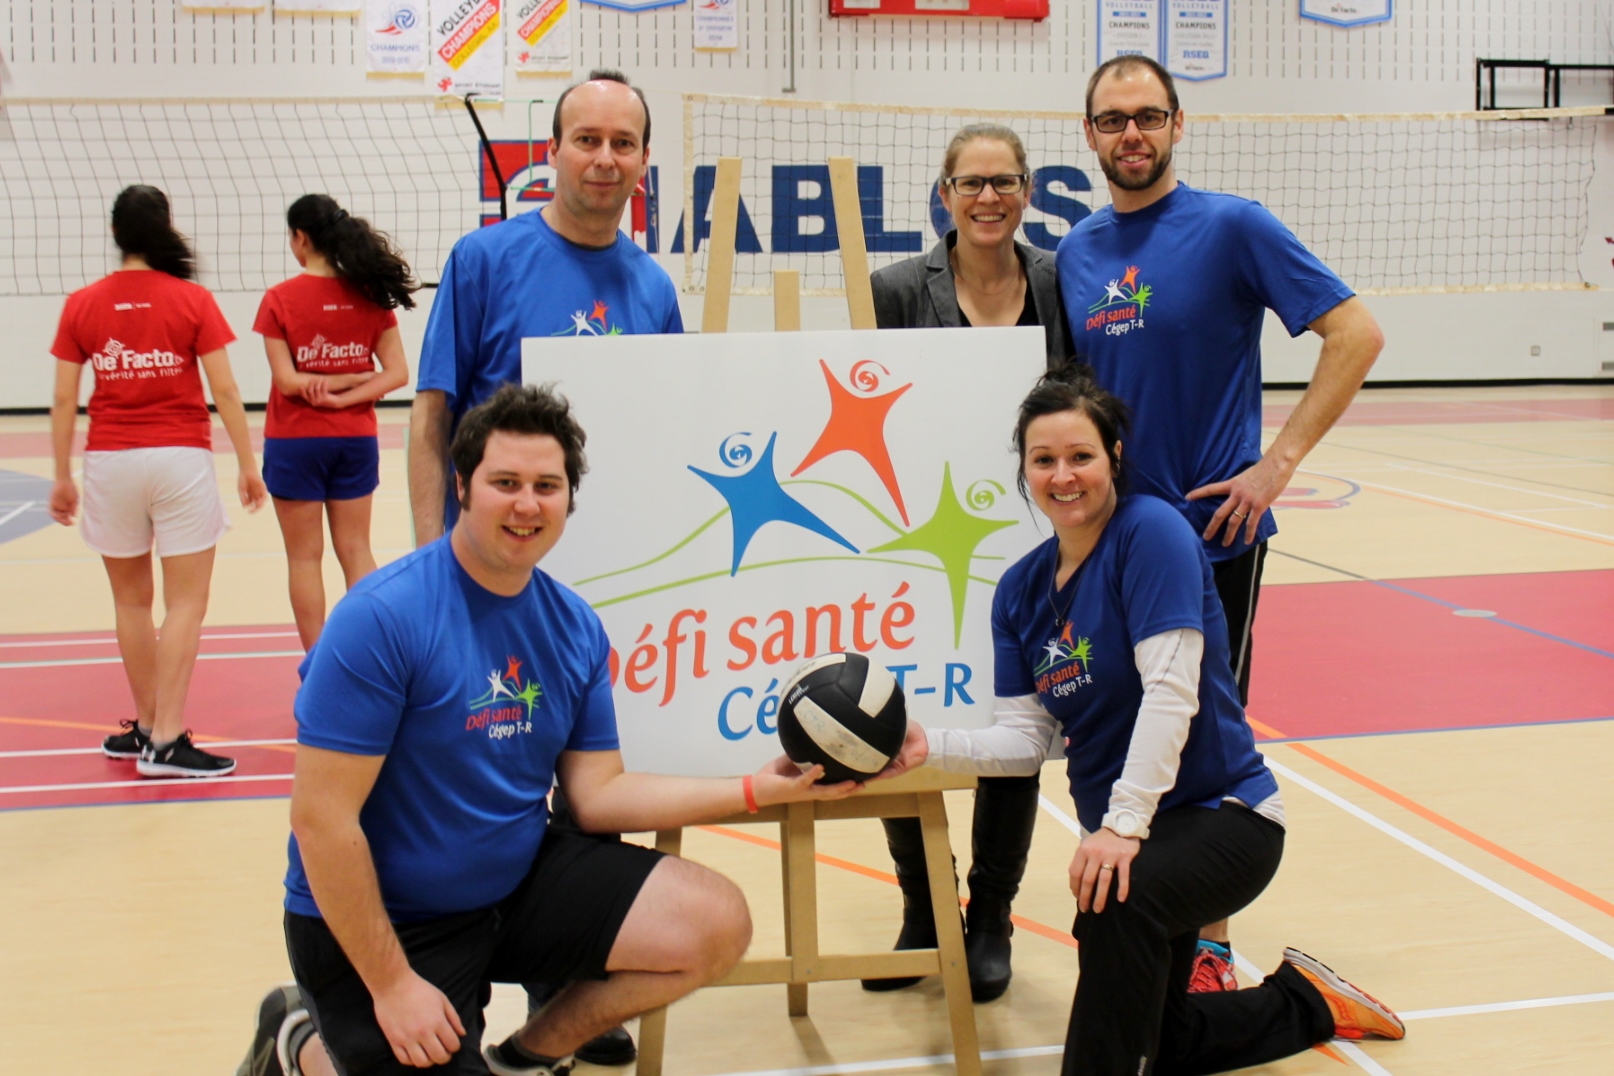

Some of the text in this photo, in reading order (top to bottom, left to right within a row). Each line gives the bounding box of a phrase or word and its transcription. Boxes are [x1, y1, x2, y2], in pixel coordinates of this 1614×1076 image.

[441, 2, 497, 58] CHAMPIONS
[1109, 21, 1150, 29] CHAMPIONS
[1175, 22, 1216, 30] CHAMPIONS
[370, 43, 420, 52] CHAMPIONS
[1086, 304, 1136, 331] Défi santé
[1105, 319, 1144, 336] Cégep T-R
[92, 352, 117, 371] De
[297, 346, 319, 363] De
[726, 581, 915, 671] santé
[1050, 661, 1080, 685] santé
[1052, 673, 1093, 697] Cégep T-R
[465, 704, 522, 731] Défi santé
[488, 721, 532, 740] Cégep T-R
